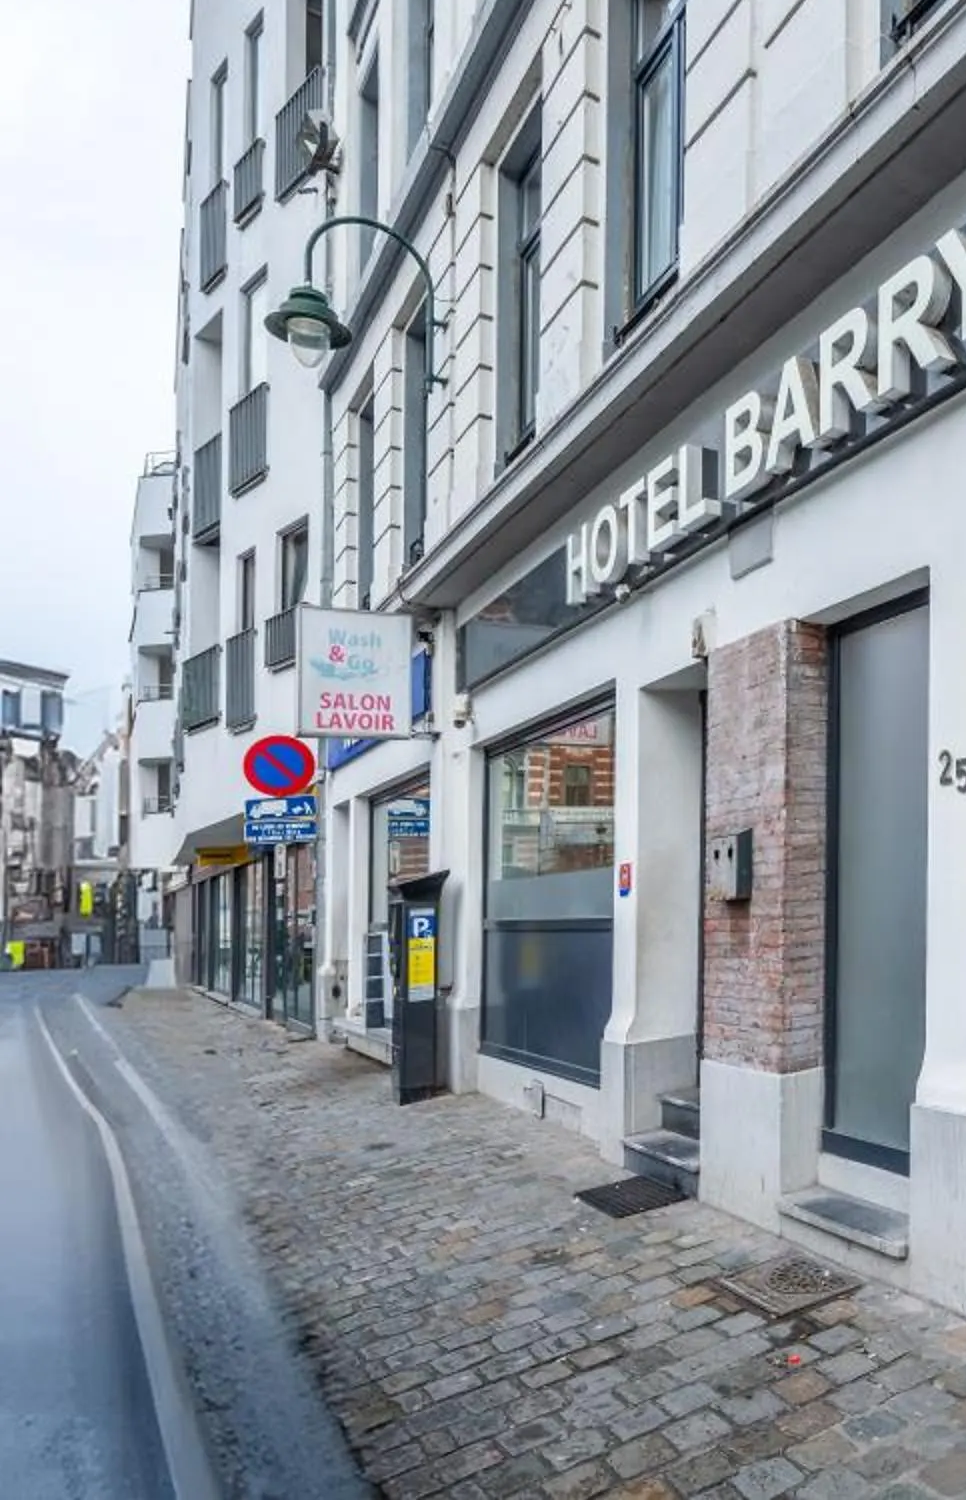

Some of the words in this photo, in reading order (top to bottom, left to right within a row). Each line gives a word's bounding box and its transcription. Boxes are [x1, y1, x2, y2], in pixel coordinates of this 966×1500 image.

[566, 444, 720, 605] HOTEL
[329, 628, 381, 648] Wash
[329, 645, 345, 662] &
[320, 692, 391, 711] SALON
[316, 712, 395, 731] LAVOIR
[413, 917, 429, 938] P
